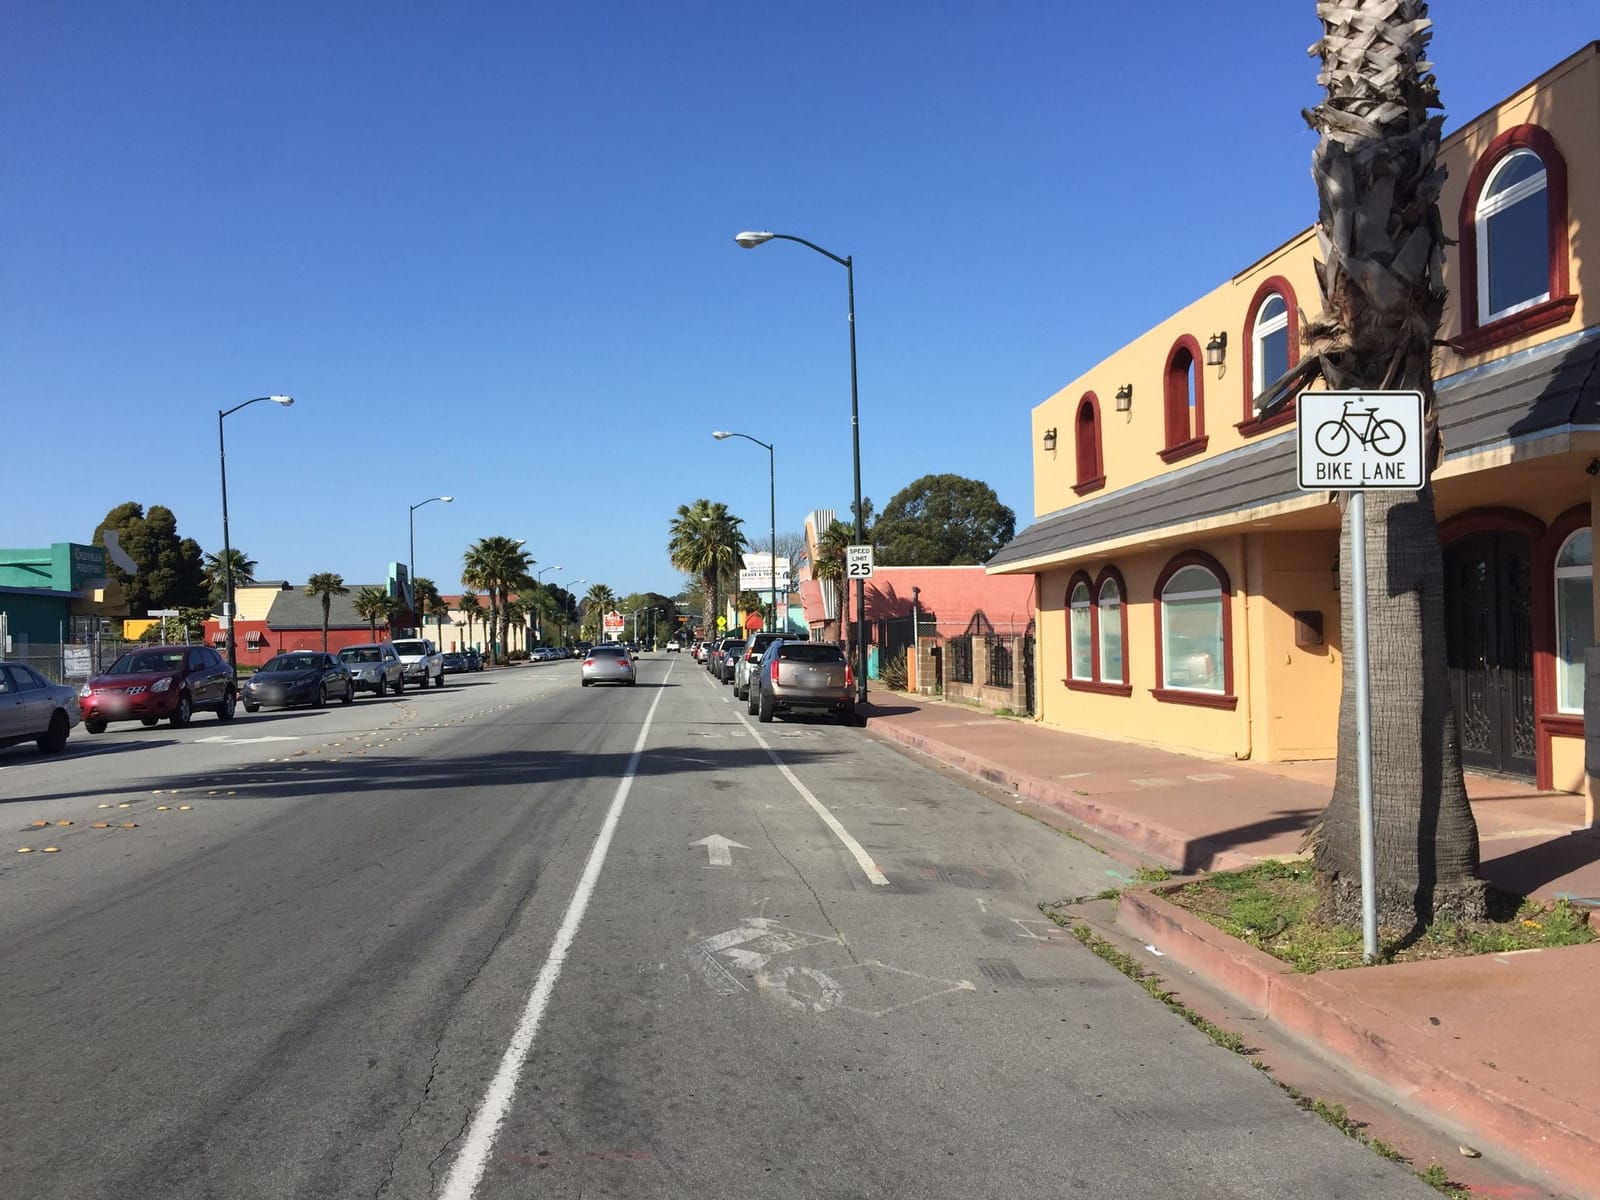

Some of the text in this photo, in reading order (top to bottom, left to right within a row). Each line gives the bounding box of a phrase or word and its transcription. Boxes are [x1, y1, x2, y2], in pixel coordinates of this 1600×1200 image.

[1316, 462, 1406, 480] BIKE LANE
[850, 563, 871, 575] 25
